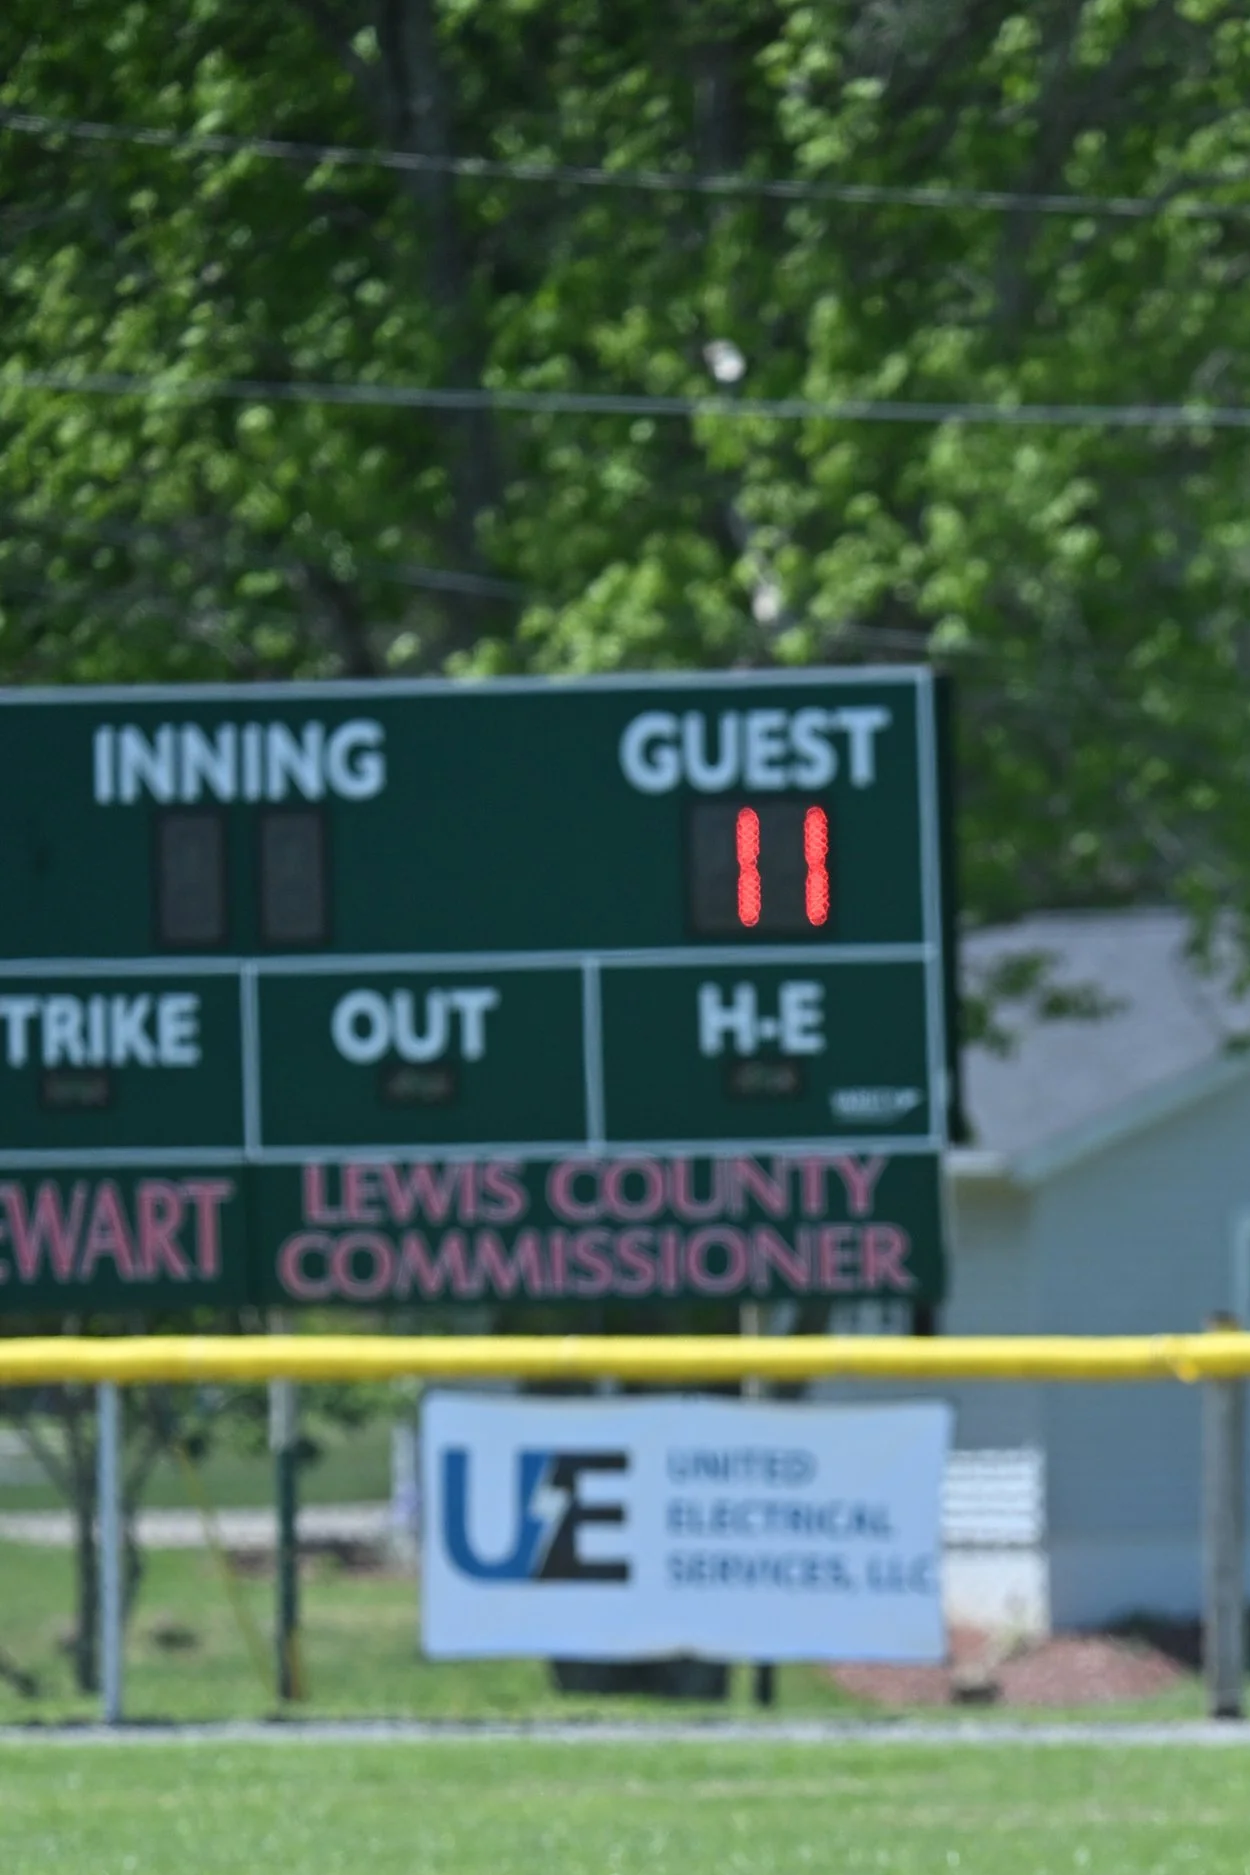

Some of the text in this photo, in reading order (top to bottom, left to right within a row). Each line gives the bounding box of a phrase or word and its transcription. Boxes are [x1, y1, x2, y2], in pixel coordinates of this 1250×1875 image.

[93, 720, 386, 805] INNING
[620, 706, 891, 794] GUEST
[736, 806, 830, 926] 11
[0, 993, 201, 1067] TRIKE
[331, 986, 501, 1064] OUT
[301, 1152, 890, 1224] LEWIS COUNTY
[278, 1223, 916, 1300] COMMISSIONER
[666, 1449, 817, 1488] UNITED
[666, 1500, 893, 1541] ELECTRICAL
[866, 1553, 940, 1594] LLC
